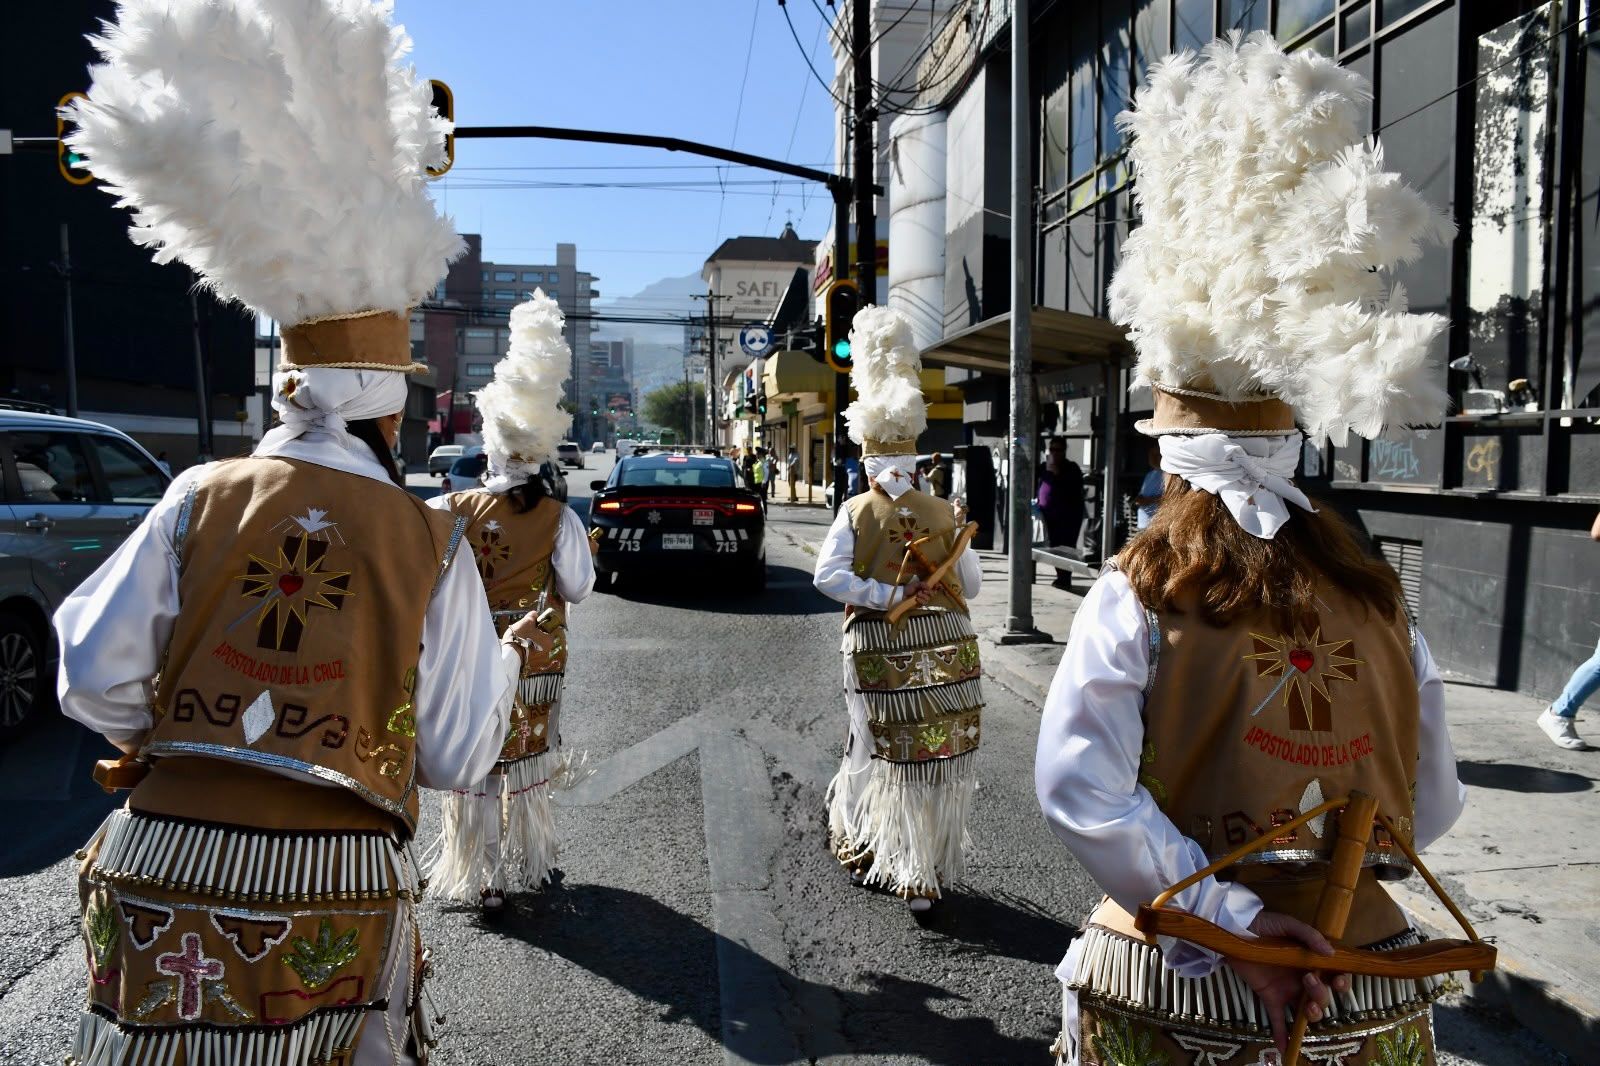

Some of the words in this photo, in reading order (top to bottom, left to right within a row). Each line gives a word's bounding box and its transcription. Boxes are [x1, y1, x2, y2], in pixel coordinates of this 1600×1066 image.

[736, 280, 778, 297] SAFI
[618, 540, 641, 552] 713
[716, 541, 738, 553] 713
[211, 640, 277, 683] APOSTOLADO
[280, 665, 292, 685] DE
[295, 665, 310, 685] LA
[313, 659, 345, 683] CRUZ
[1243, 725, 1319, 767] APOSTOLADO
[1322, 745, 1335, 767] DE
[1336, 744, 1349, 765] LA
[1349, 732, 1374, 761] CRUZ
